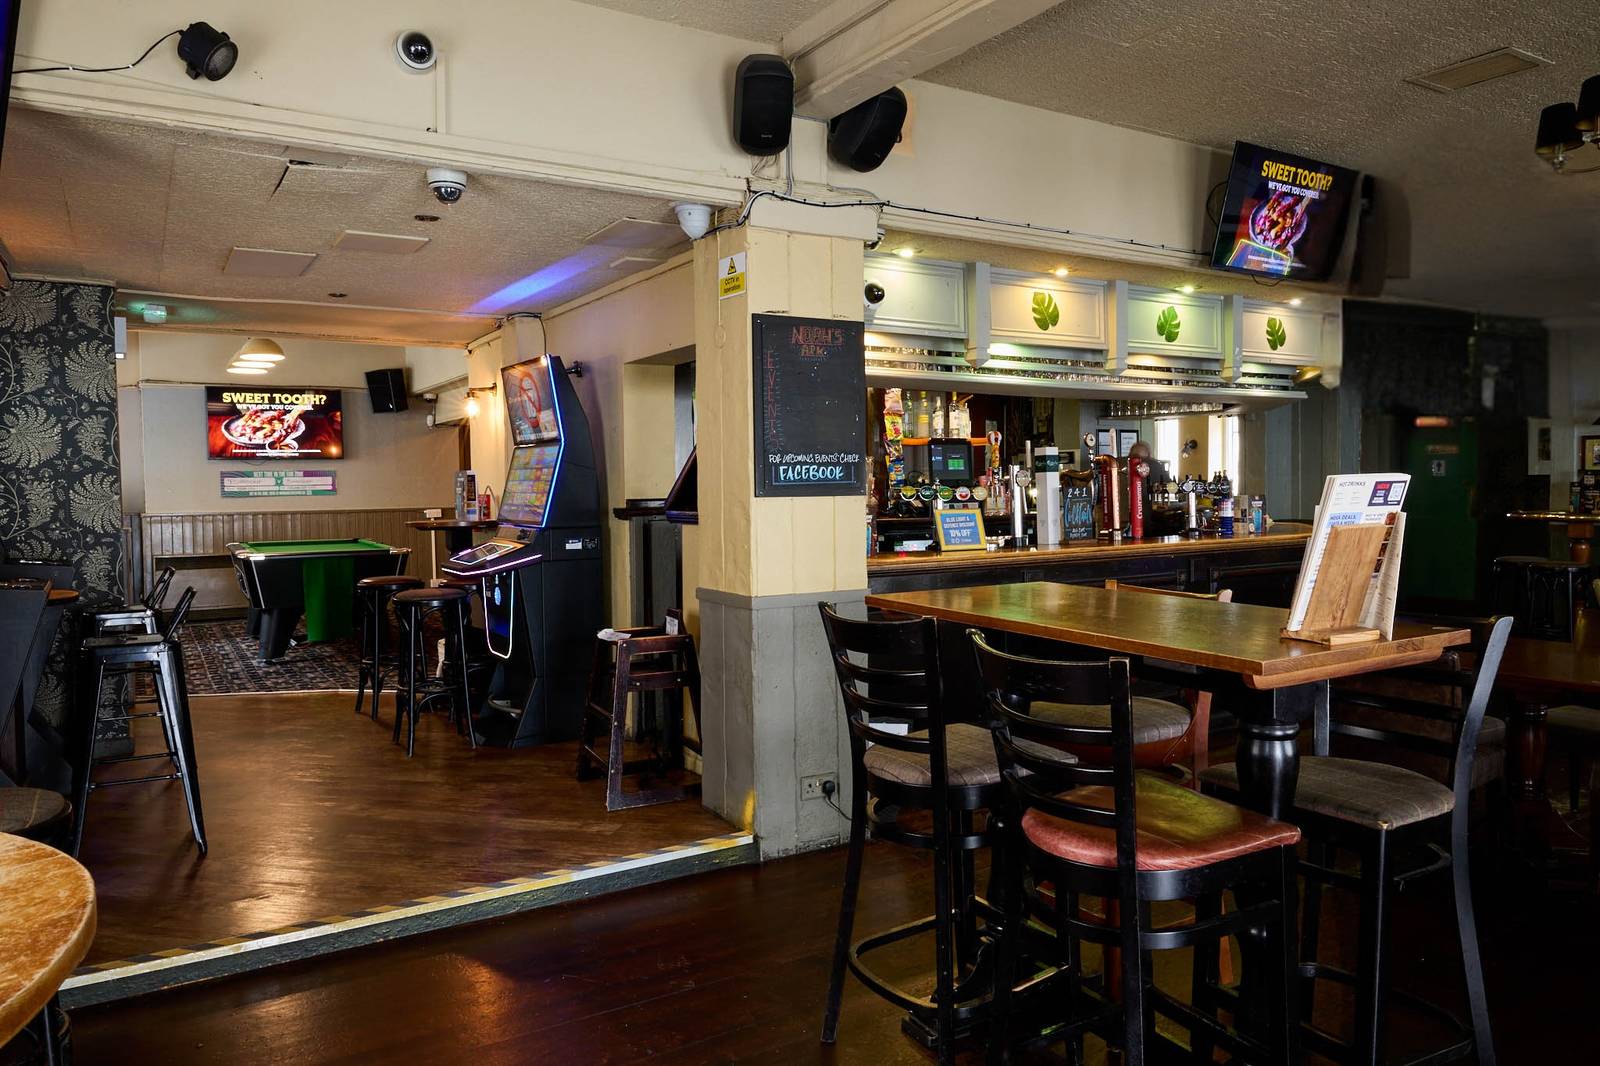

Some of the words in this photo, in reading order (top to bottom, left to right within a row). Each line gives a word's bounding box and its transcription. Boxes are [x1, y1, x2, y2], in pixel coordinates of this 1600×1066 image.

[1261, 160, 1296, 183] SWEET
[1296, 168, 1333, 191] TOOTH?
[1268, 180, 1283, 192] WE'VE
[1282, 184, 1292, 193] GOT
[1291, 186, 1301, 195] YOU
[222, 392, 271, 404] SWEET
[273, 393, 327, 405] TOOTH?
[769, 454, 781, 463] FOR
[839, 453, 860, 463] CHECK
[779, 465, 844, 481] FACEBOOK
[950, 529, 961, 537] 10%
[961, 529, 971, 537] OFF
